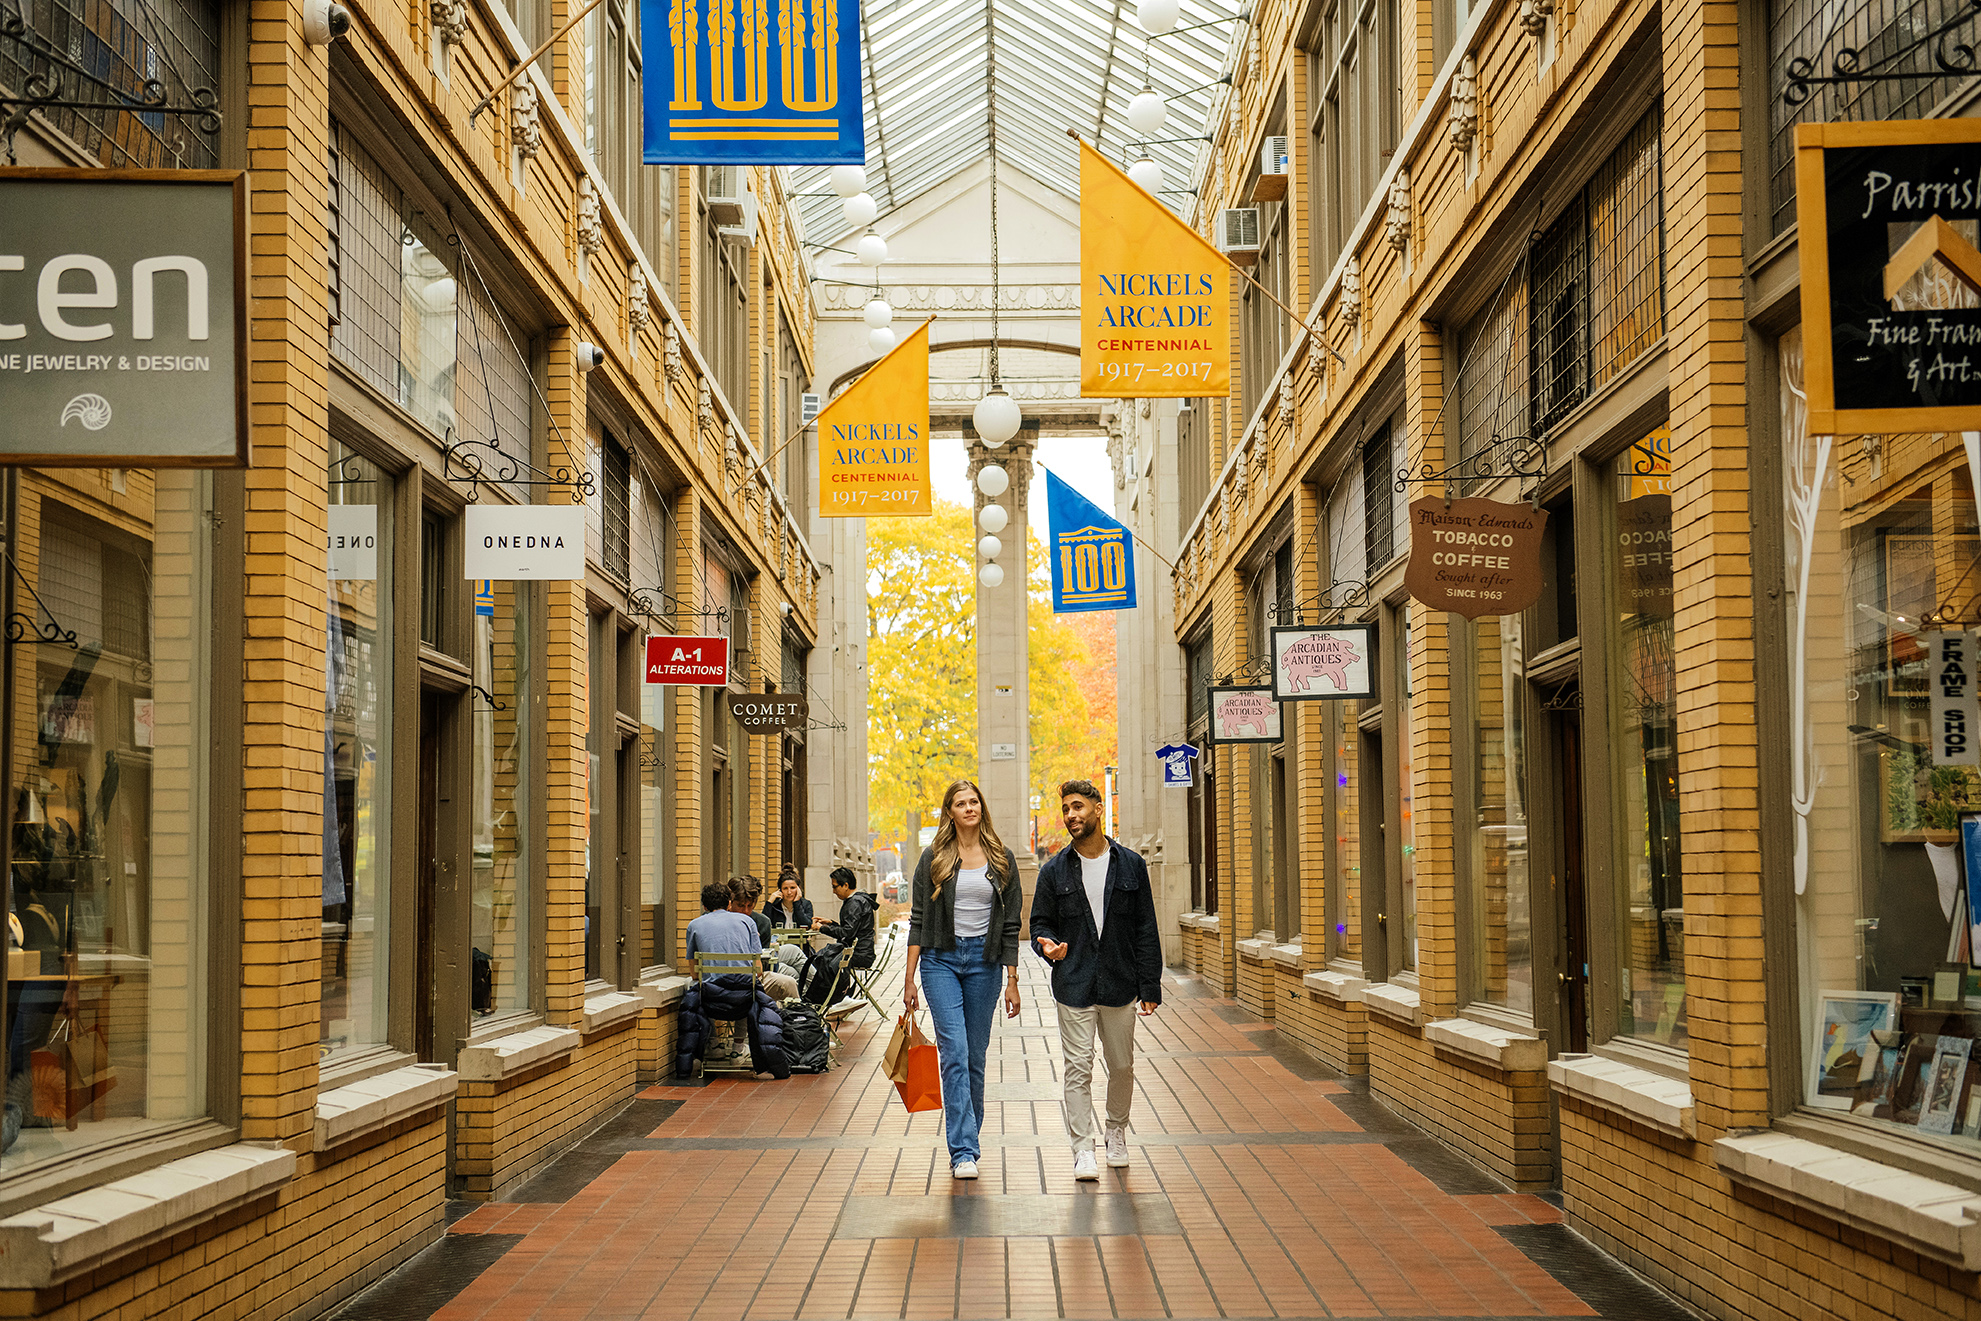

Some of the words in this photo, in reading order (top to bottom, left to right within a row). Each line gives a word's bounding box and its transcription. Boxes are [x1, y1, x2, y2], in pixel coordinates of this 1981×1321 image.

[1098, 273, 1213, 296] NICKELS
[1097, 305, 1213, 328] ARCADE
[1867, 316, 1921, 347] Fine
[1097, 339, 1213, 351] CENTENNIAL
[24, 354, 113, 373] JEWELRY
[117, 355, 131, 371] &
[136, 355, 210, 371] DESIGN
[1906, 357, 1921, 393] &
[1926, 352, 1972, 383] Art
[831, 423, 919, 441] NICKELS
[831, 447, 919, 465] ARCADE
[831, 473, 920, 483] CENTENNIAL
[483, 535, 565, 549] ONEDNA
[1432, 530, 1514, 547] TOBACCO
[1059, 541, 1126, 592] 100
[1432, 552, 1510, 569] COFFEE
[1435, 569, 1475, 585] Sought
[1480, 573, 1513, 589] after
[1310, 633, 1331, 642] THE
[671, 648, 702, 662] A-1
[1291, 642, 1340, 654] ARCADIAN
[1291, 654, 1342, 665] ANTIQUES
[1940, 638, 1967, 698] FRAME
[649, 665, 724, 676] ALTERATIONS
[733, 703, 798, 716] COMET
[1224, 698, 1262, 707] ARCADIAN
[1224, 707, 1263, 716] ANTIQUES
[744, 717, 787, 725] COFFEE
[1943, 709, 1966, 758] SHOP
